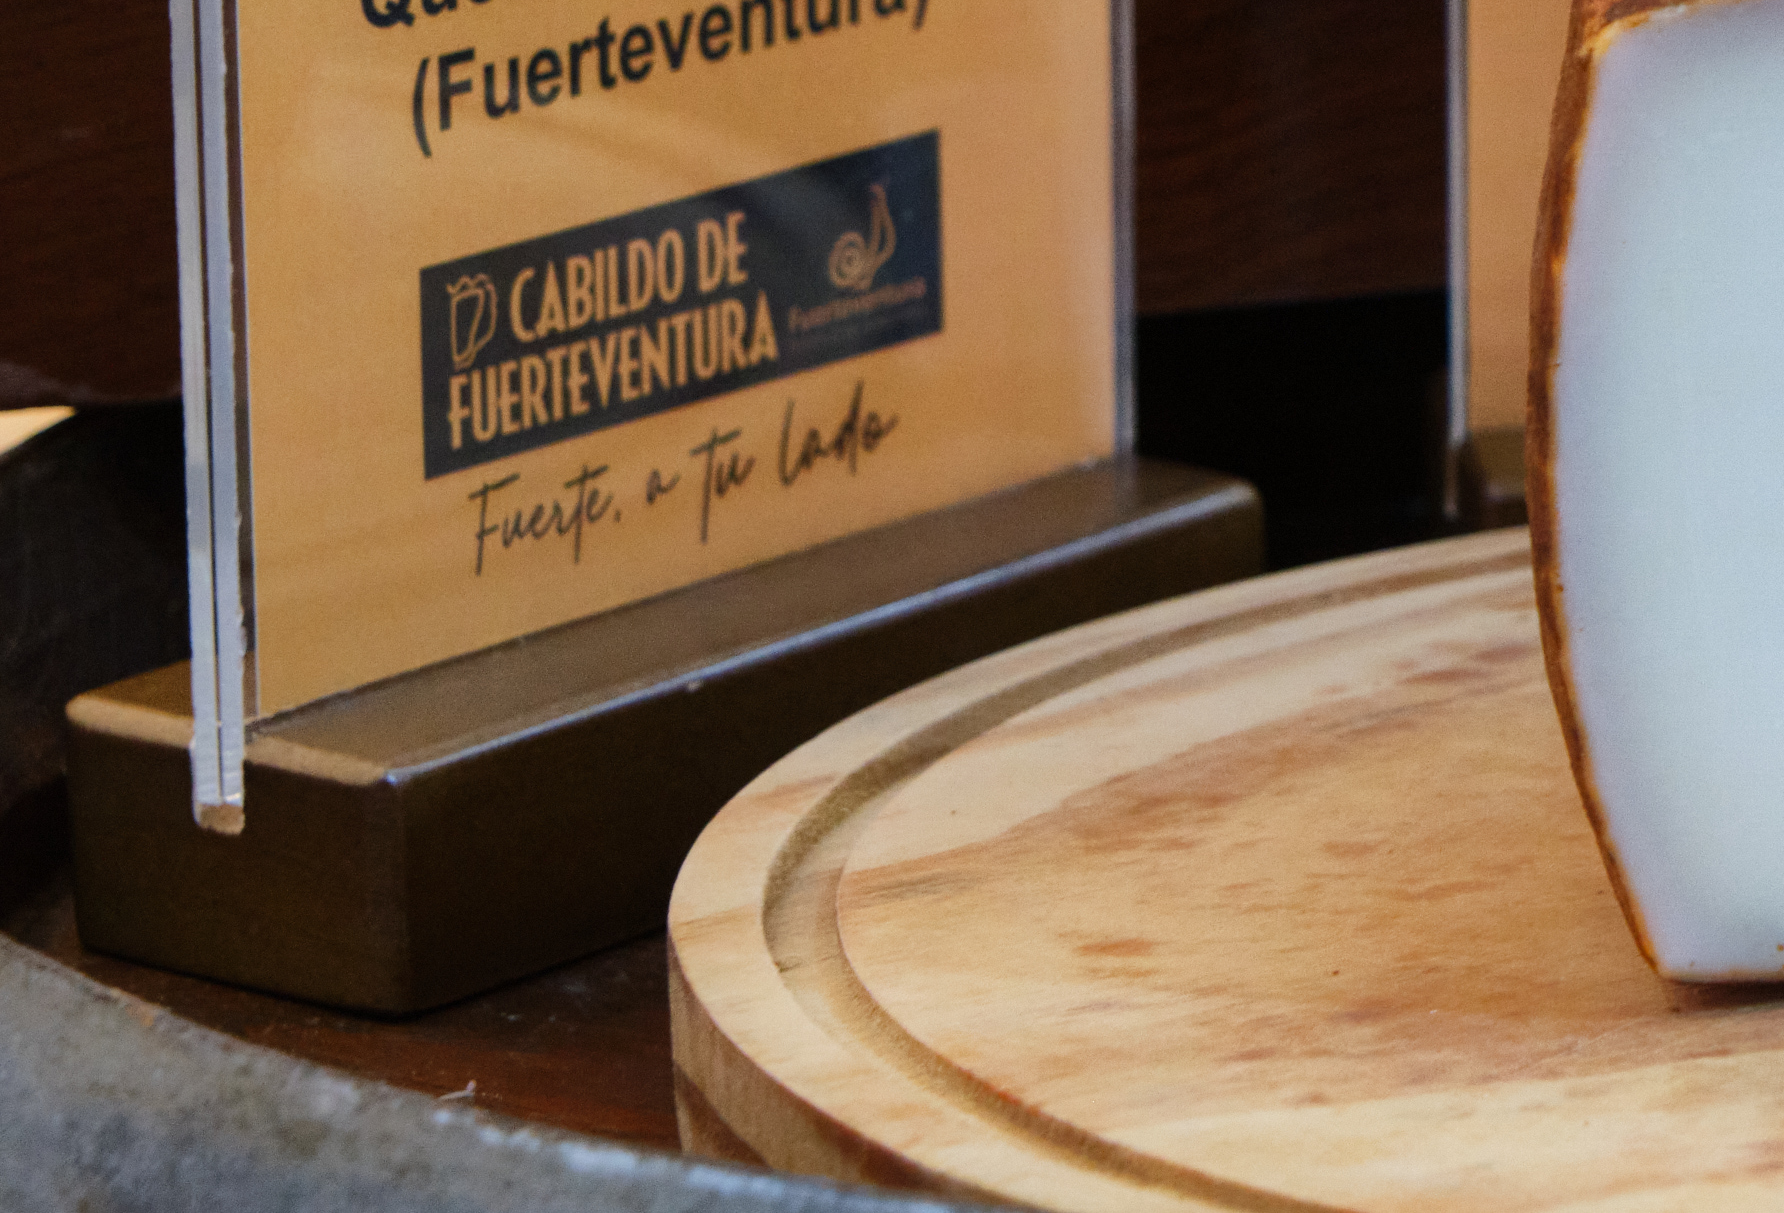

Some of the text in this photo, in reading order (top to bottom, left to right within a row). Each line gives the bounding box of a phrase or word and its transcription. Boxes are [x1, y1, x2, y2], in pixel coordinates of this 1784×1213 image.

[509, 228, 687, 342] CABILDO
[697, 210, 749, 295] DE
[448, 290, 780, 451] FUERTEVENTURA
[468, 464, 622, 577] Fuerte,
[645, 469, 680, 505] a
[778, 378, 900, 488] lado
